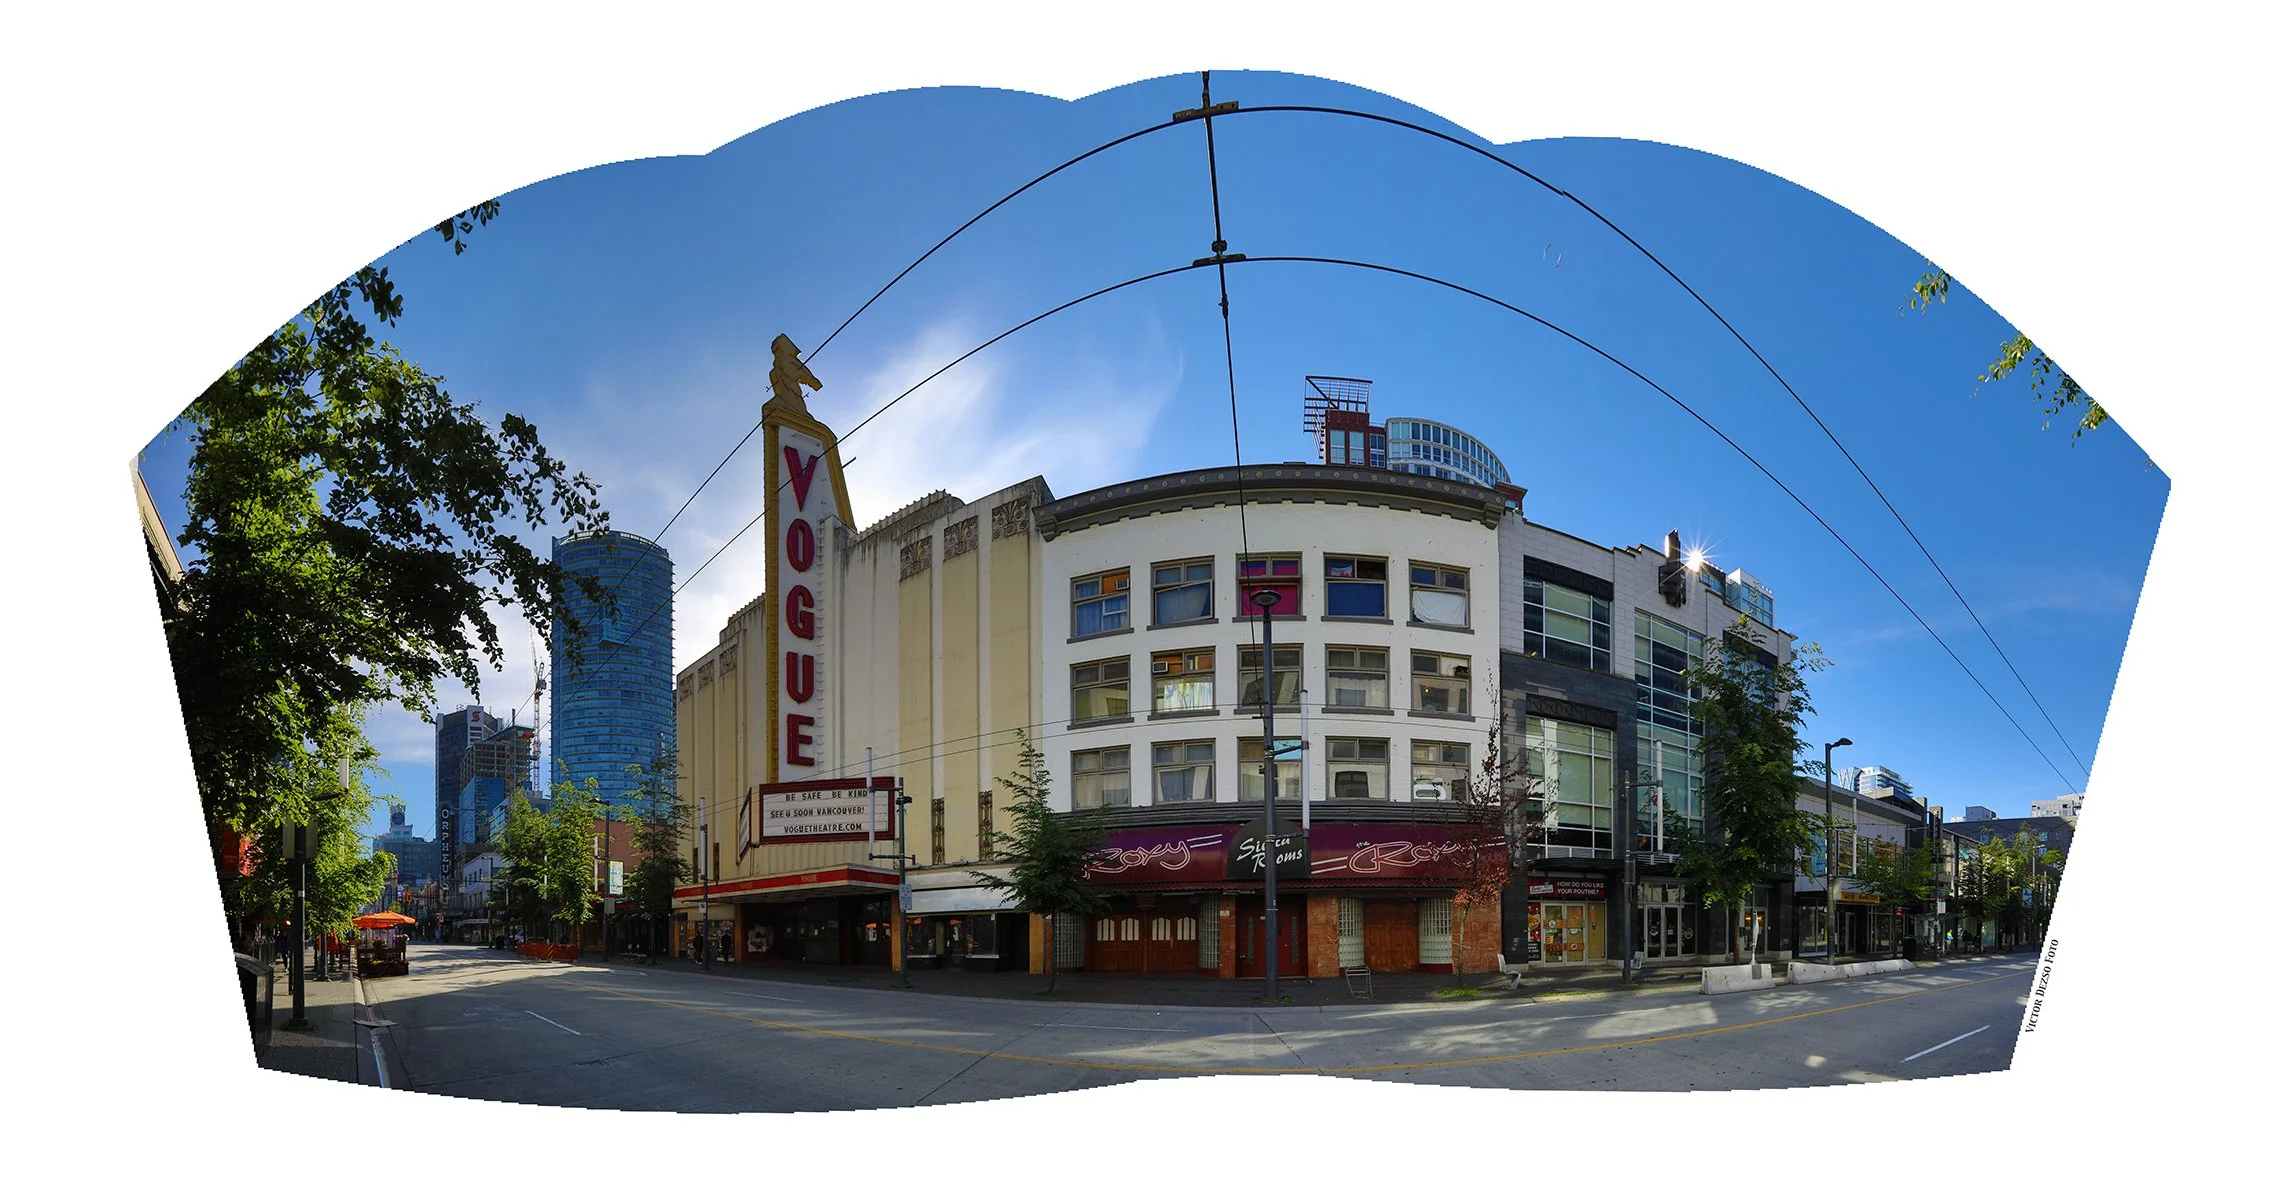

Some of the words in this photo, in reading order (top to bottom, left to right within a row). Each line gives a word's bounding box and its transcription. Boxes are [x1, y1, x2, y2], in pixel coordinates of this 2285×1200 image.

[783, 445, 818, 767] VOGUE
[785, 793, 796, 801] BE
[802, 792, 821, 800] SAFE
[832, 791, 842, 799] BE
[848, 789, 868, 798] KIND
[770, 810, 784, 819] SEE
[793, 809, 813, 817] SOON
[817, 807, 865, 816] VANCOUVER!
[784, 823, 862, 834] VOGUETHEATRE.COM
[441, 808, 450, 884] ORPHEUM
[1251, 849, 1304, 873] Roms
